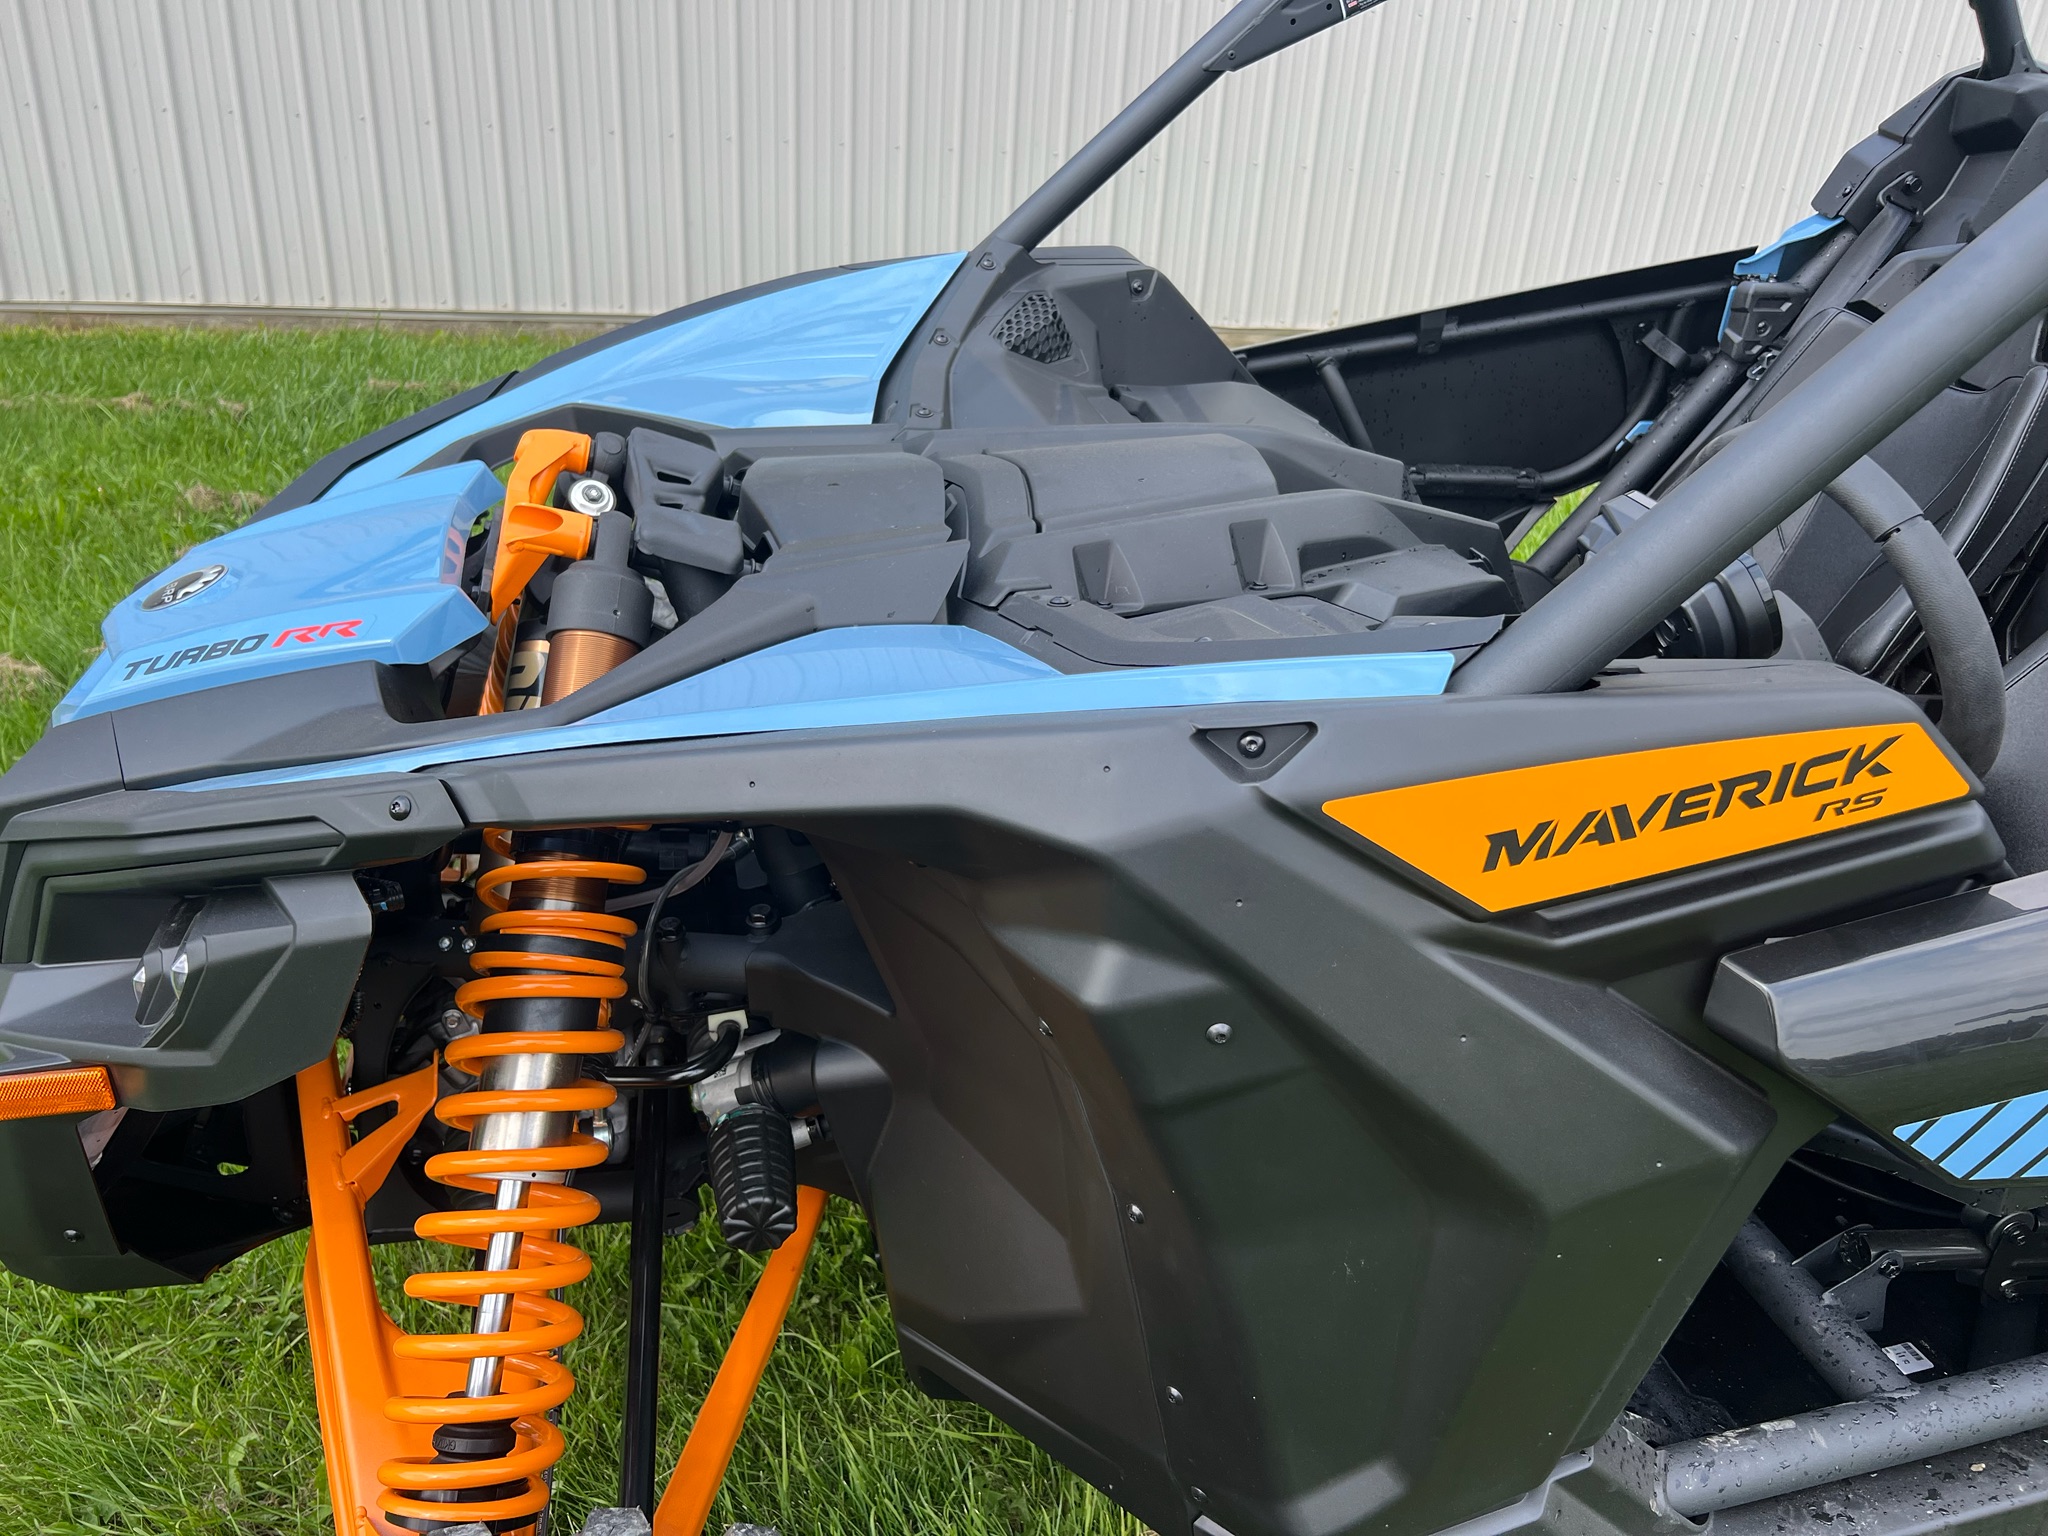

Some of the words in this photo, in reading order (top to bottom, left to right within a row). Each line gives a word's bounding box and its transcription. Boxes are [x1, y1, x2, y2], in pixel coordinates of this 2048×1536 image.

[161, 581, 179, 603] BRP
[123, 633, 269, 681] TURBO
[271, 619, 363, 649] RR
[1482, 734, 1905, 874] MAVERICK
[1812, 787, 1888, 823] RS
